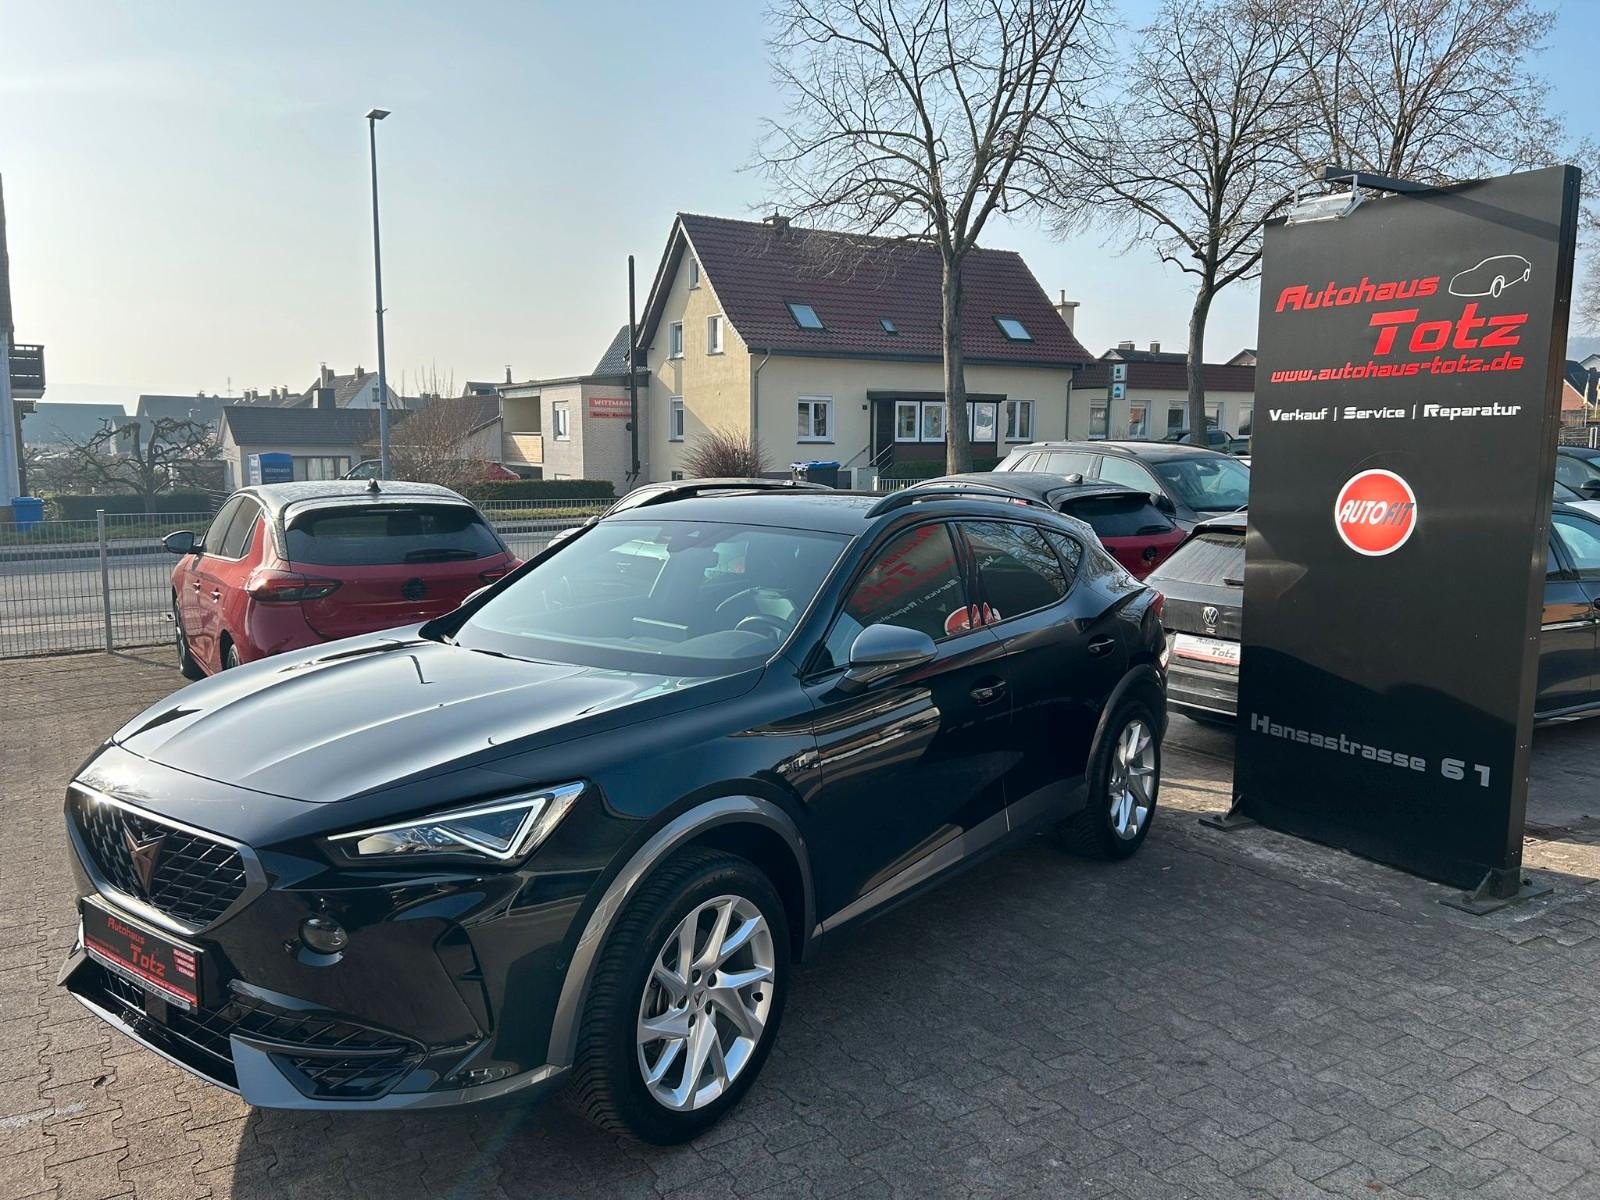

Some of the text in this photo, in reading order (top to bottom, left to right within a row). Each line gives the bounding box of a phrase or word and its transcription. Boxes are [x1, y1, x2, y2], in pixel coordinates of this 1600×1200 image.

[1275, 276, 1440, 312] Autohaus
[1369, 303, 1528, 355] Totz
[1270, 352, 1524, 383] www.autohaus-totz.de
[1269, 408, 1328, 422] Verkauf
[1343, 407, 1405, 420] Service
[1423, 402, 1521, 421] Reparatur
[1212, 647, 1236, 659] Totz
[1251, 712, 1426, 772] Hansastrasse
[107, 916, 145, 945] Autohaus
[130, 943, 167, 977] Totz
